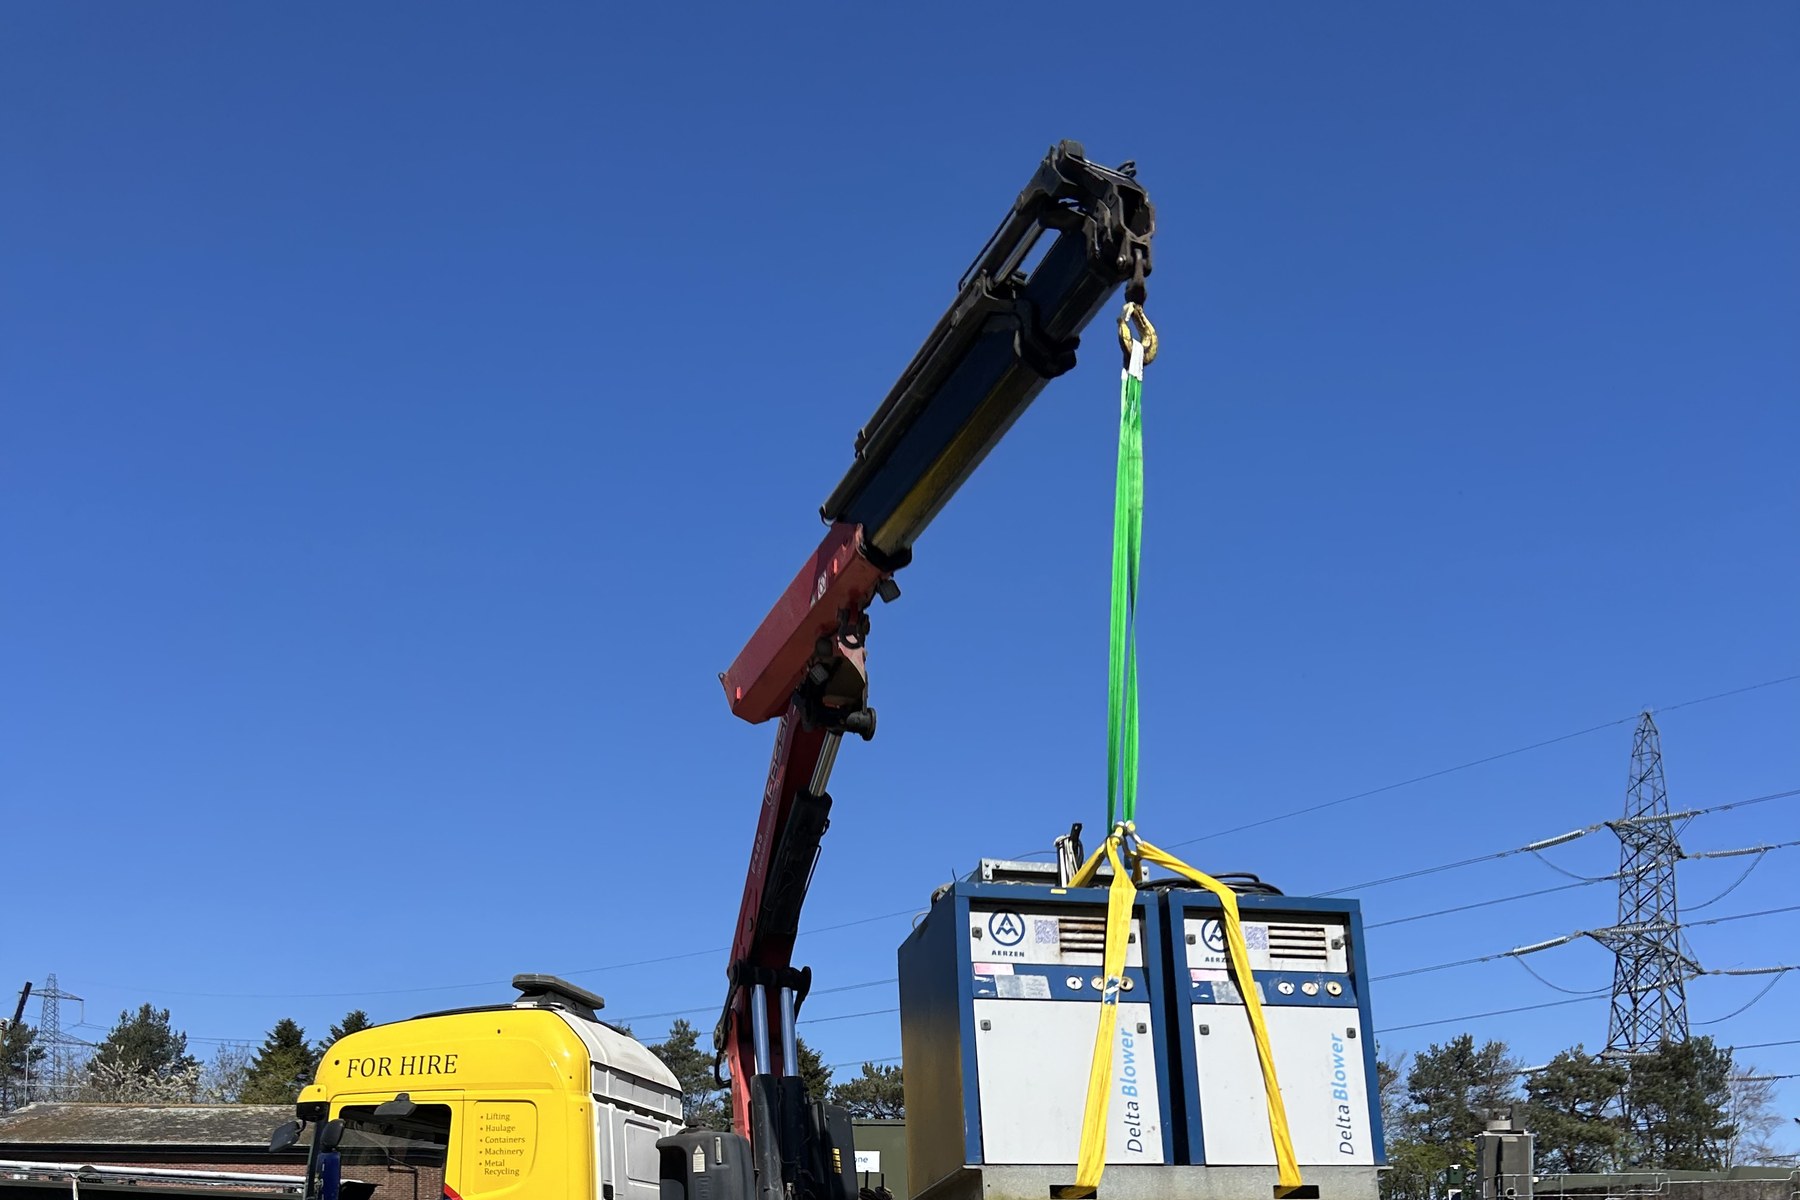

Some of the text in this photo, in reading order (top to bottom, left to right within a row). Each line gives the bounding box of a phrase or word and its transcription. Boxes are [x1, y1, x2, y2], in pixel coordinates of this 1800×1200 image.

[991, 950, 1025, 958] AERZEN
[346, 1054, 459, 1078] FOR HIRE
[1119, 1027, 1143, 1153] Delta Blower
[1330, 1032, 1354, 1155] Delta Blower
[485, 1113, 511, 1122] Lifting
[485, 1124, 516, 1134] Haulage
[484, 1136, 526, 1144] Containers
[484, 1148, 525, 1157] Machinery
[484, 1159, 505, 1167] Metal
[484, 1168, 520, 1177] Recycling
